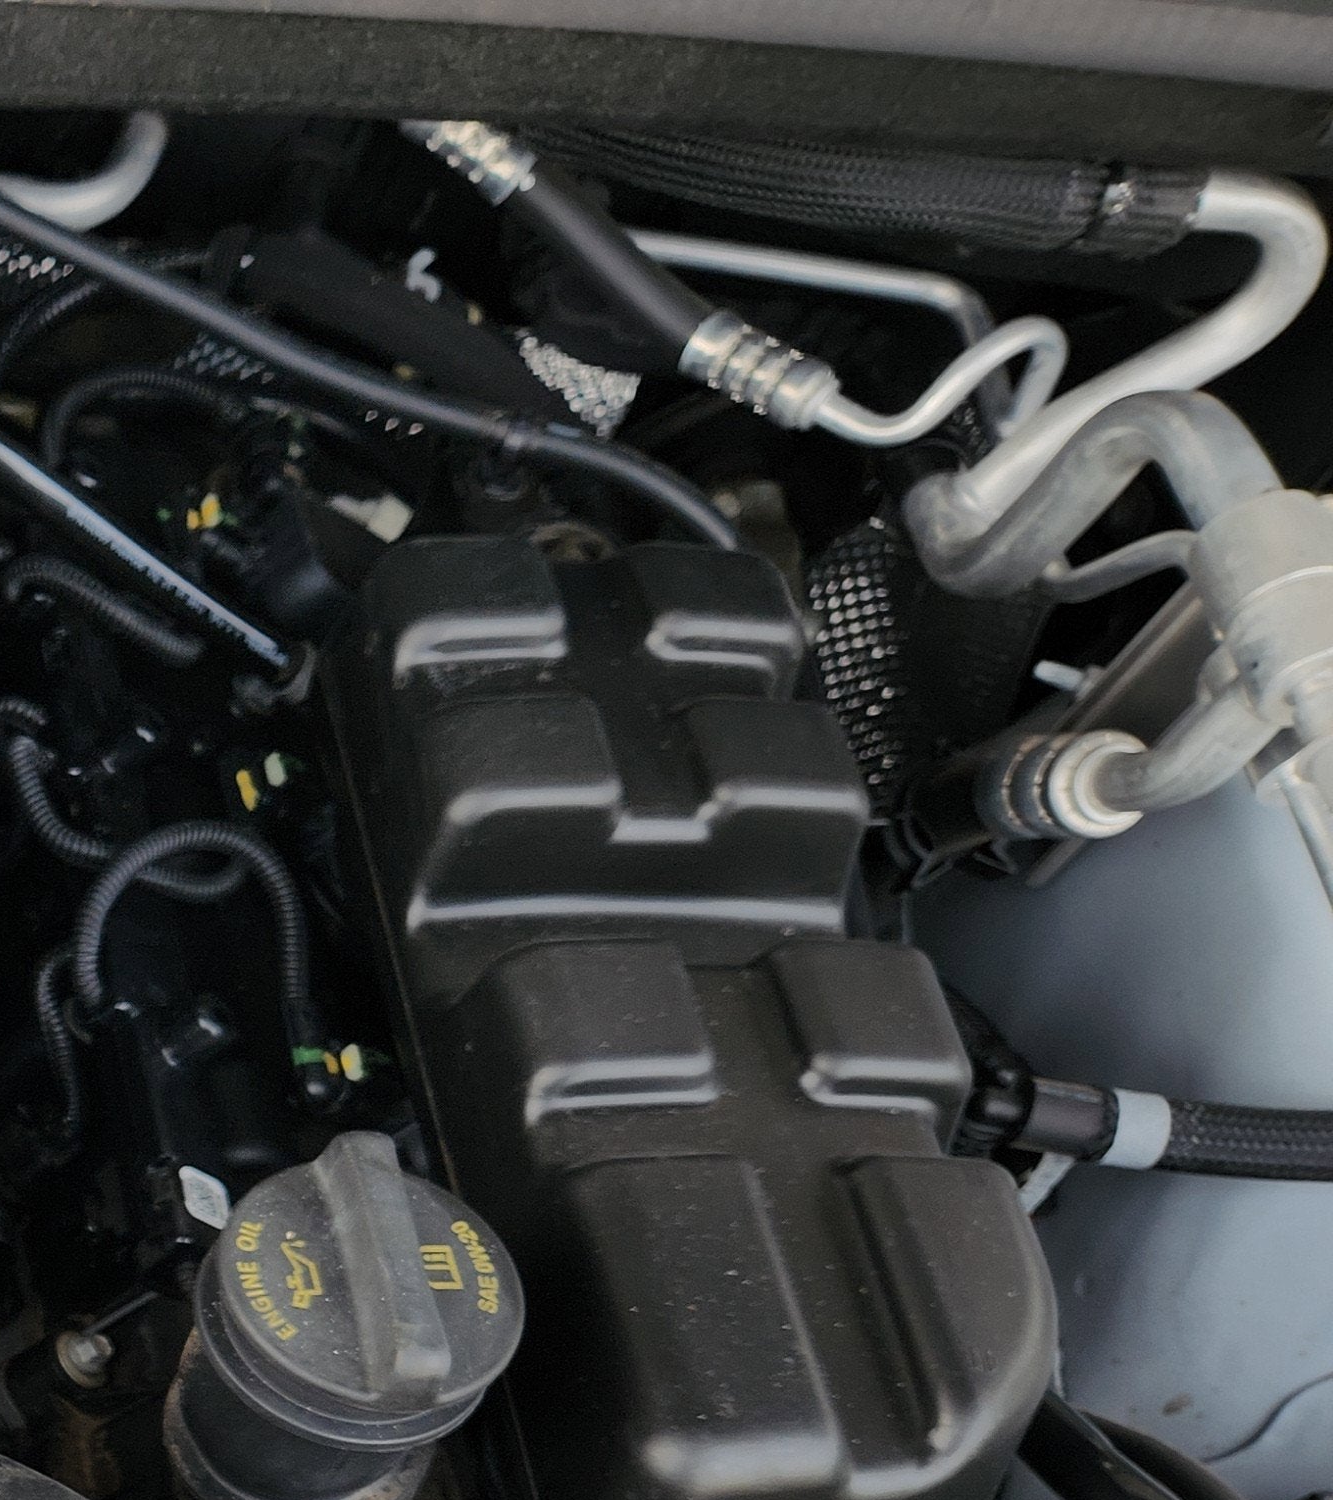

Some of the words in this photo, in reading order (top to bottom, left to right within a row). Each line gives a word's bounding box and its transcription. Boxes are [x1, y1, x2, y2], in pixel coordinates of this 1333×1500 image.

[236, 1220, 264, 1252] OIL
[450, 1220, 496, 1274] 0W-20
[236, 1260, 299, 1341] ENGINE
[477, 1275, 500, 1315] SAE
